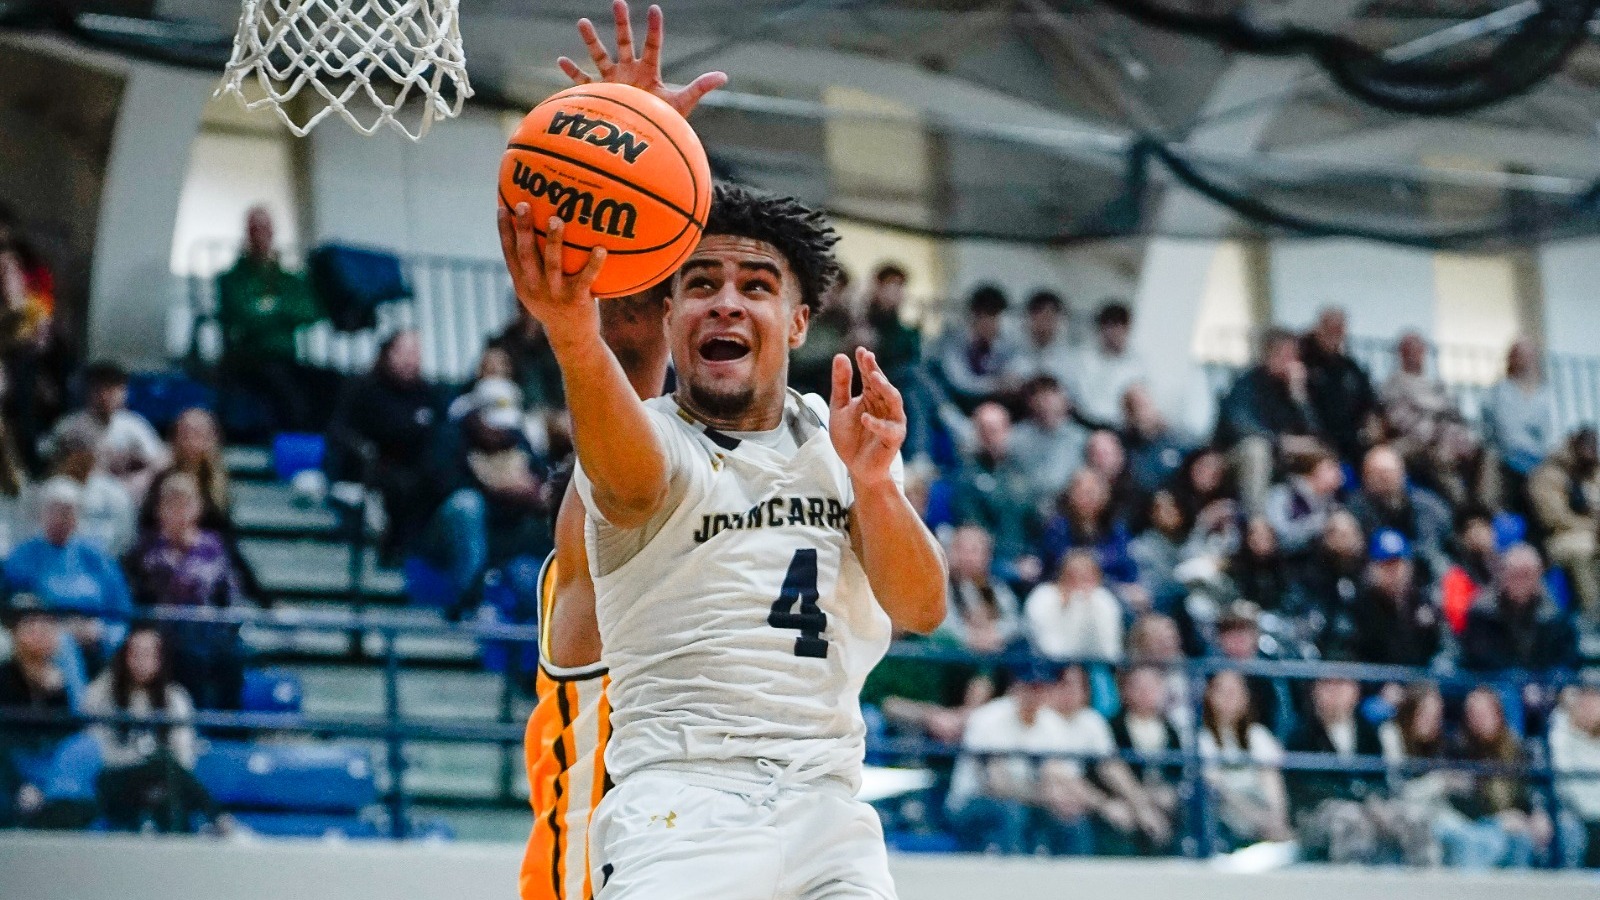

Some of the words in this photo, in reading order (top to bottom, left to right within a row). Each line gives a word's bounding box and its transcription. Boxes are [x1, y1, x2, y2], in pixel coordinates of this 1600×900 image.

[548, 111, 649, 164] NCAA
[512, 158, 637, 239] Wilson
[767, 548, 829, 658] 4
